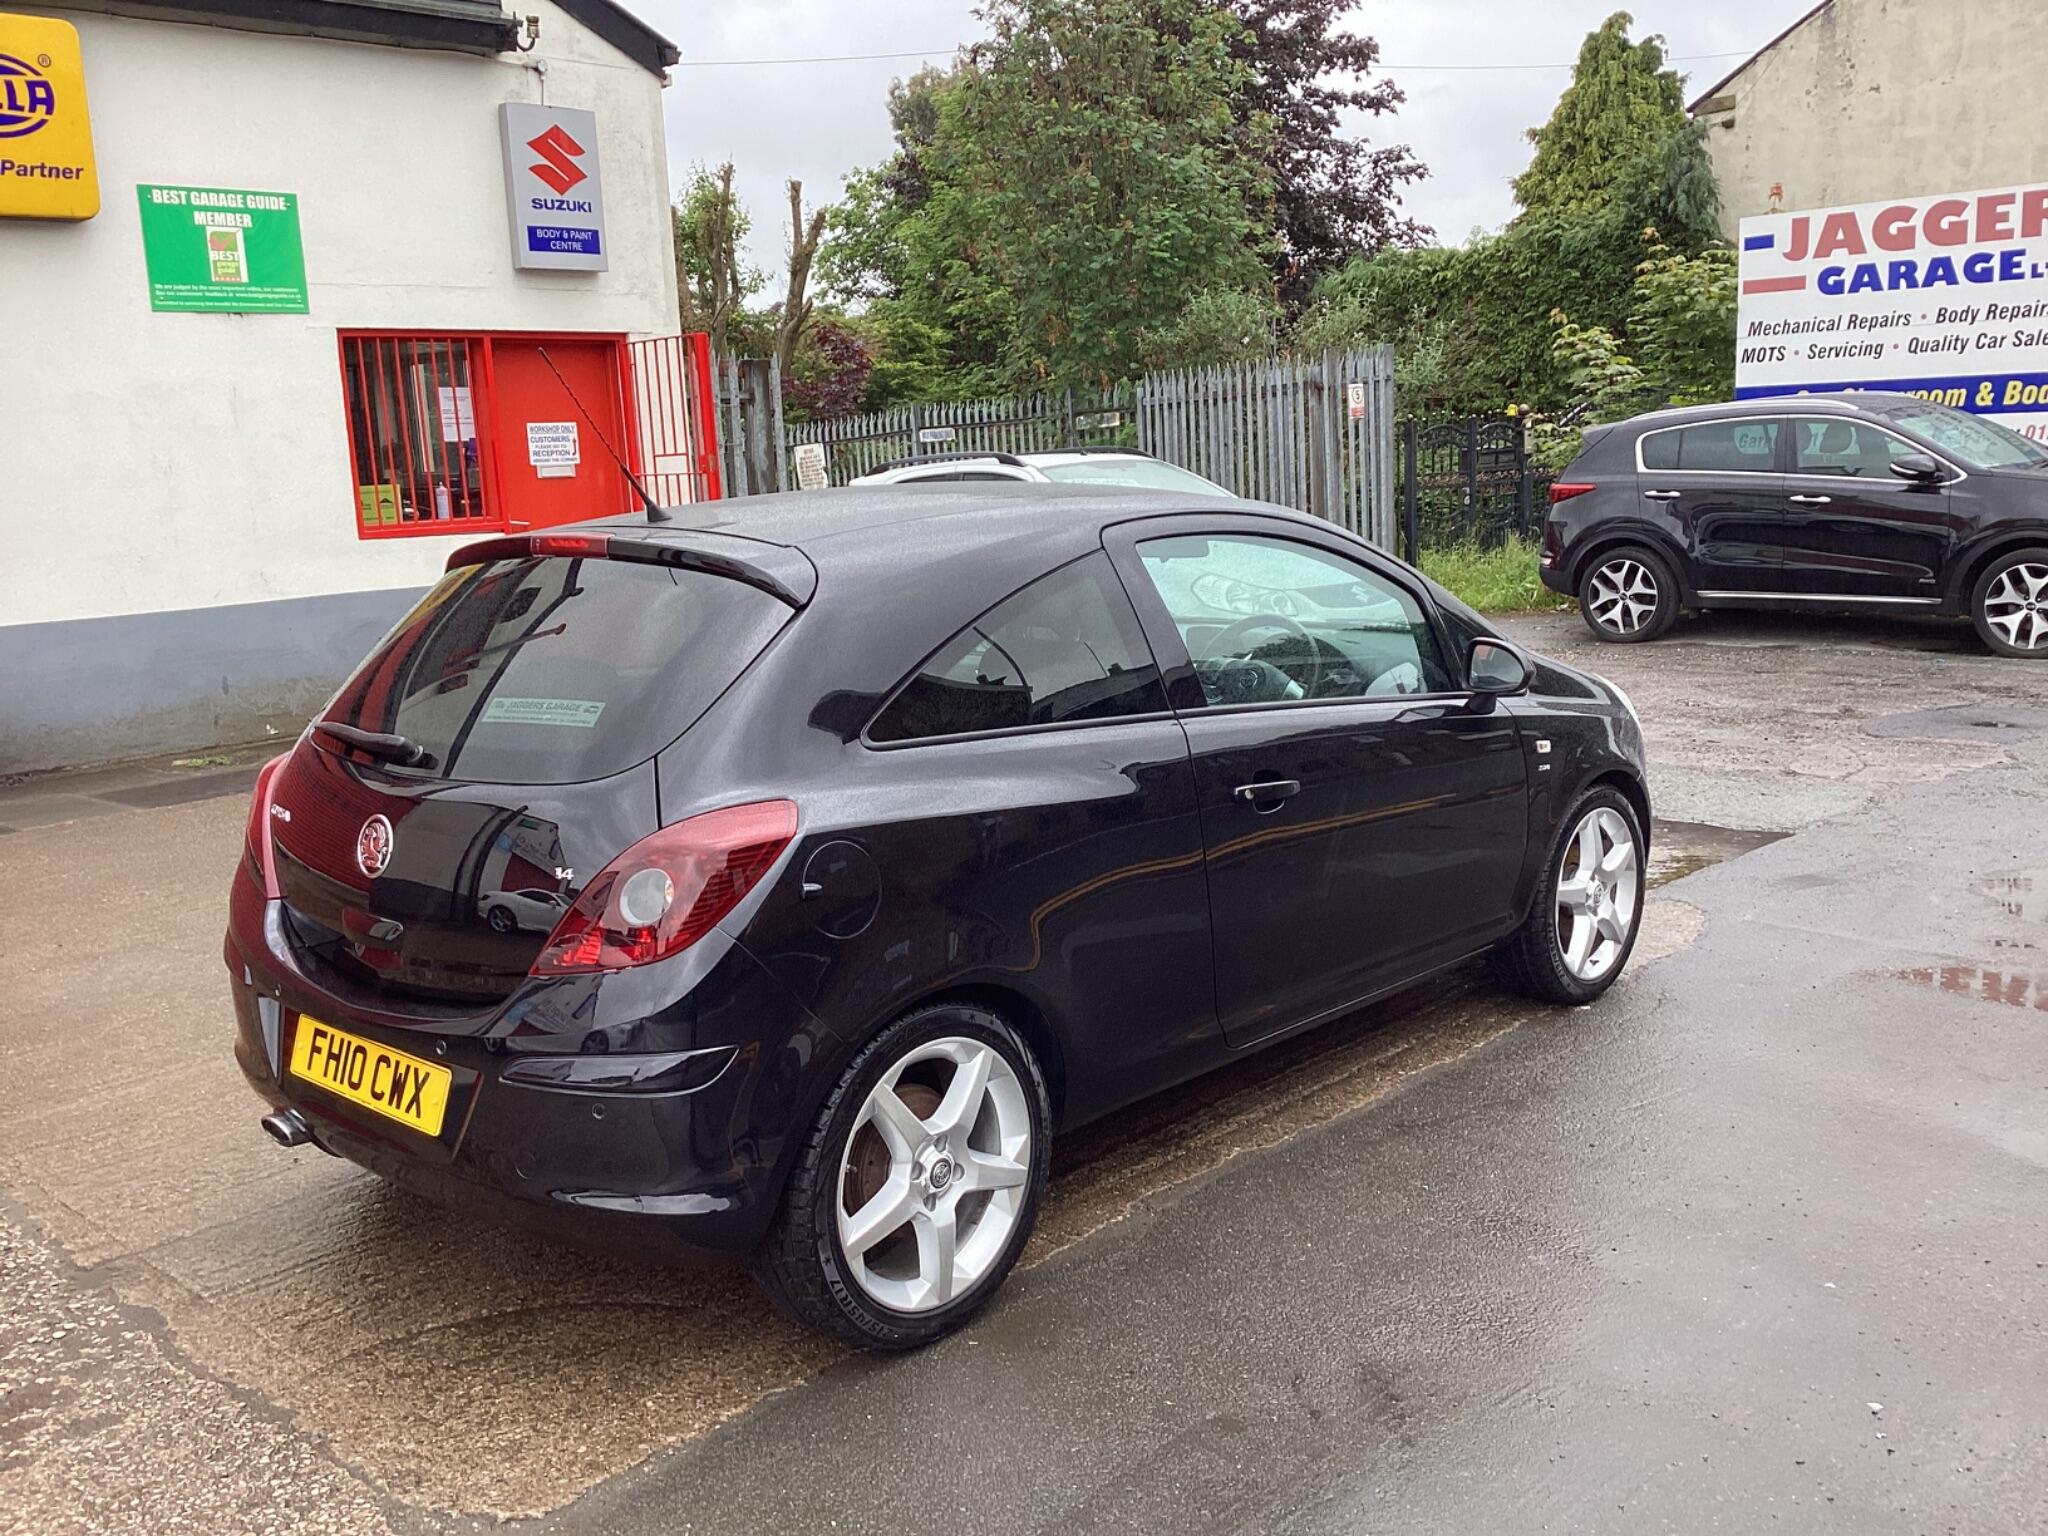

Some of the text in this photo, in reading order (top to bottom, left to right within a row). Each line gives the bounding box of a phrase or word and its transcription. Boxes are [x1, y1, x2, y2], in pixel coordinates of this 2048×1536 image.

[0, 159, 84, 180] Partner
[152, 189, 287, 211] BEST GARAGE GUIDE
[531, 198, 592, 213] SUZUKI
[193, 211, 252, 227] MEMBER
[536, 228, 592, 240] BODY & PAINT
[210, 250, 239, 261] BEST
[550, 241, 583, 251] CENTRE
[1817, 248, 2026, 295] GARAGE
[1748, 299, 2048, 337] Mechanical Repairs Body Repair
[1741, 345, 1786, 364] MOTS
[1807, 340, 1884, 360] Servicing
[1908, 335, 1969, 354] Quality
[1975, 332, 2007, 350] Car
[1975, 381, 1994, 406] &
[561, 424, 575, 432] ONLY
[307, 1027, 430, 1119] FH10 CWX
